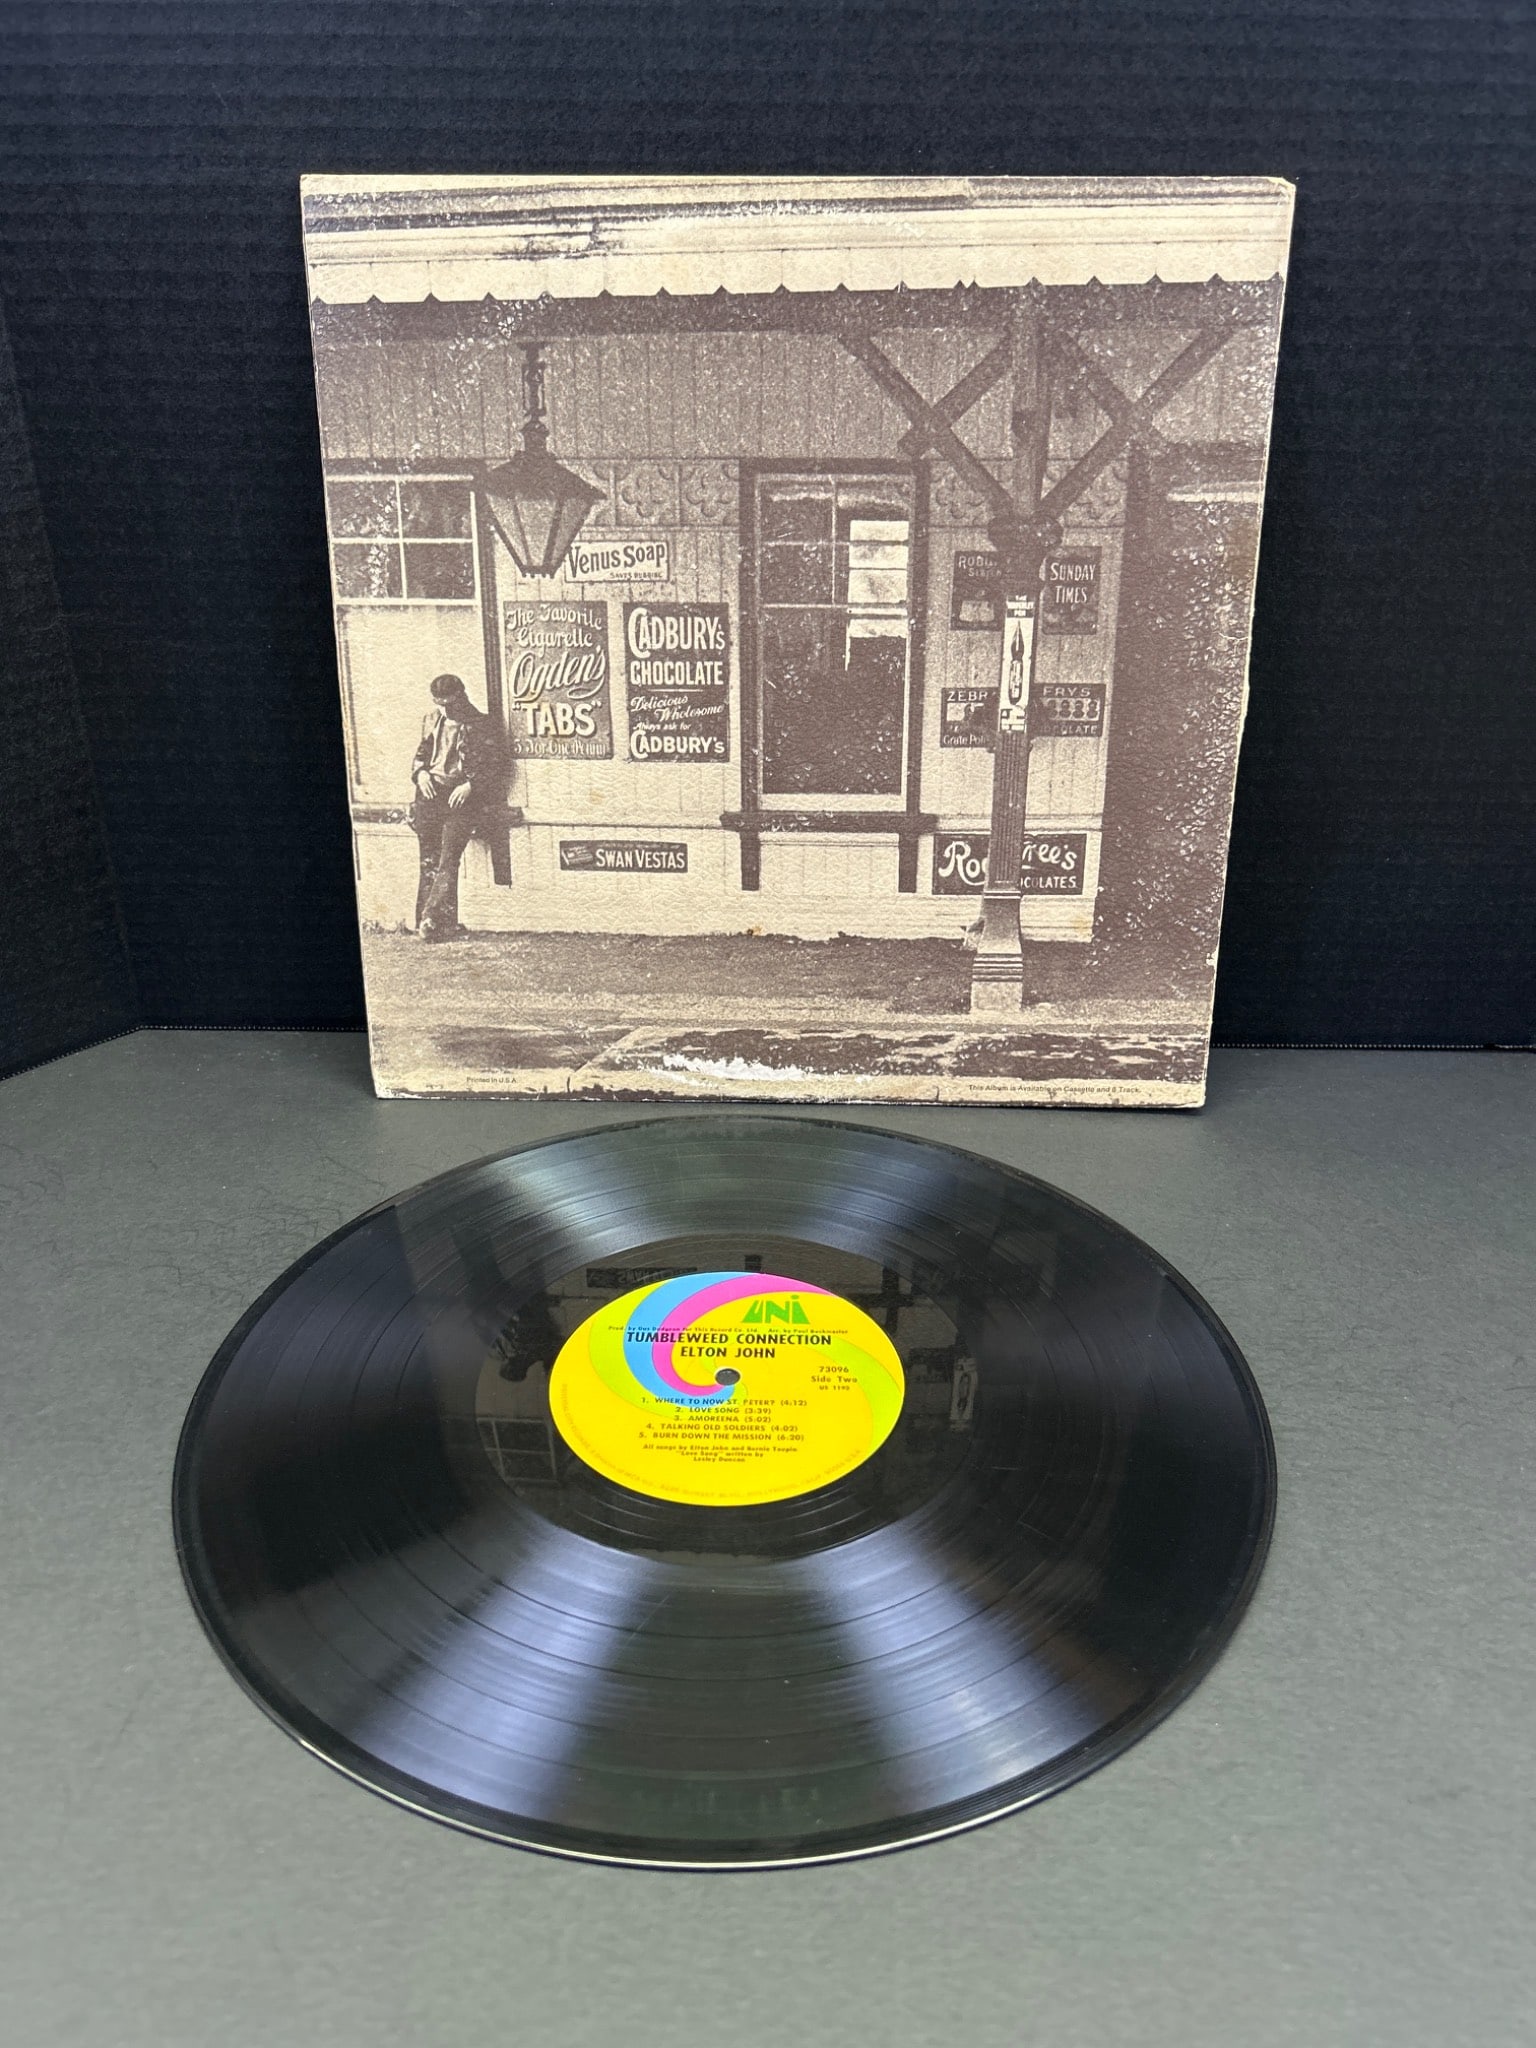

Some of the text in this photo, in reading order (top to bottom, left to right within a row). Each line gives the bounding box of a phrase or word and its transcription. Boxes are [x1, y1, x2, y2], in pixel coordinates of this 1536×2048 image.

[569, 543, 665, 578] Venus Soap
[1050, 562, 1096, 581] SUNDAY
[1055, 585, 1088, 604] TIMES
[506, 603, 602, 630] The Favorite
[518, 627, 593, 658] Cigarette
[510, 645, 606, 702] Ogden's
[630, 660, 723, 686] CHOCOLATE
[630, 695, 688, 712] Delicious
[947, 690, 996, 702] ZEBR
[654, 705, 724, 721] Wholesome
[596, 848, 633, 868] SWAN
[635, 849, 685, 869] VESTAS
[1018, 1085, 1050, 1093] Available
[627, 1331, 832, 1346] TUMBLEWEED CONNECTION
[680, 1345, 776, 1359] ELTON JOHN
[819, 1365, 849, 1374] 73096
[811, 1375, 858, 1383] Side Two
[654, 1397, 685, 1405] WHERE
[702, 1398, 724, 1406] NOW
[743, 1399, 775, 1407] PETER?
[688, 1415, 740, 1423] AMOREENA
[660, 1423, 700, 1431] TALKING
[723, 1424, 766, 1432] SOLDIERS
[732, 1433, 772, 1441] MISSION
